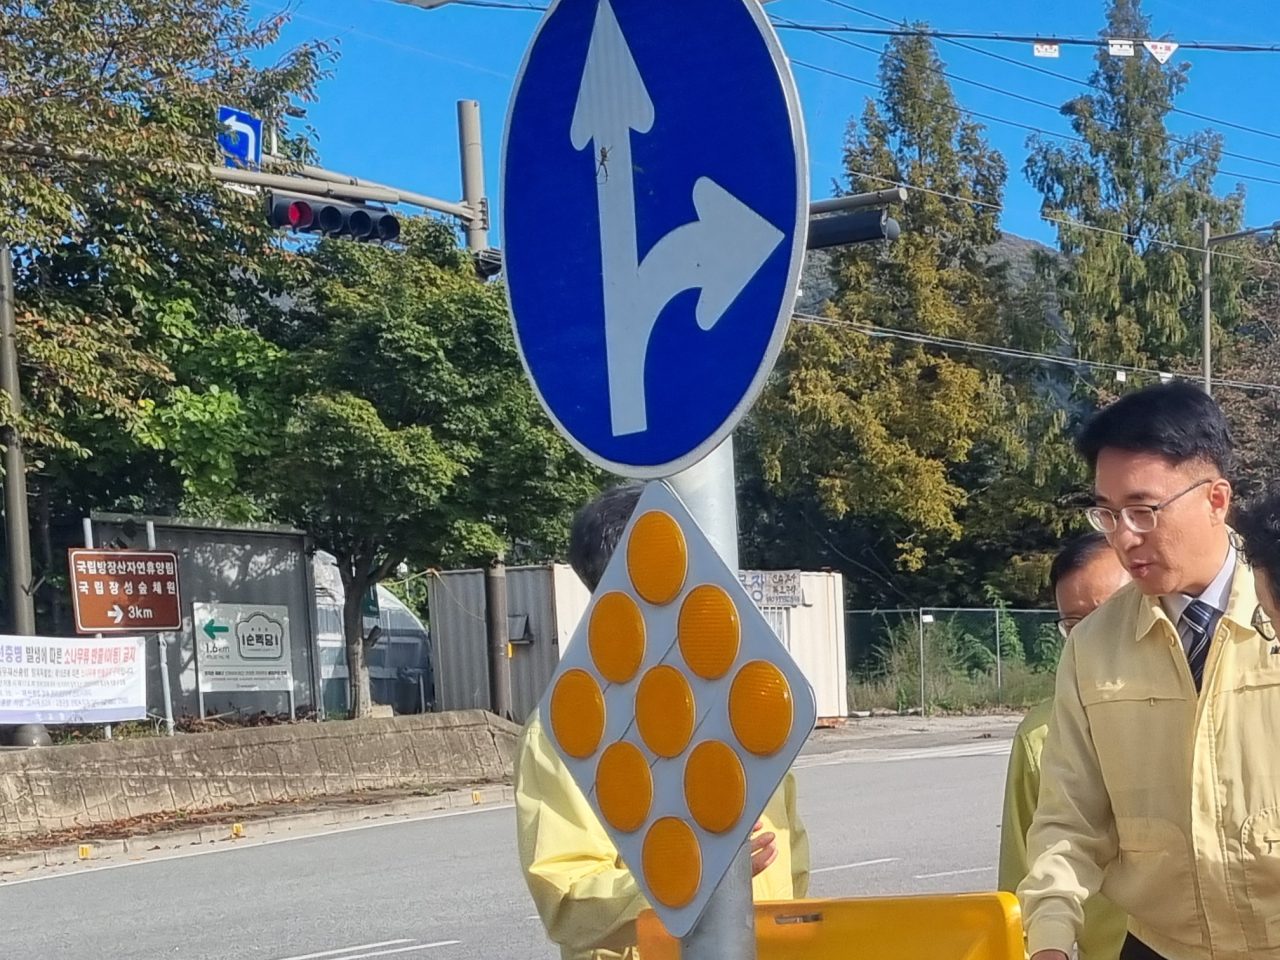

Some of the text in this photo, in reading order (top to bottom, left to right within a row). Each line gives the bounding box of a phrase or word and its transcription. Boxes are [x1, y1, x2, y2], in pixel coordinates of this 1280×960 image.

[76, 560, 174, 576] 국립방장산자연휴양림
[128, 606, 153, 619] 3km
[26, 646, 47, 664] 발생에
[50, 647, 62, 664] 따른
